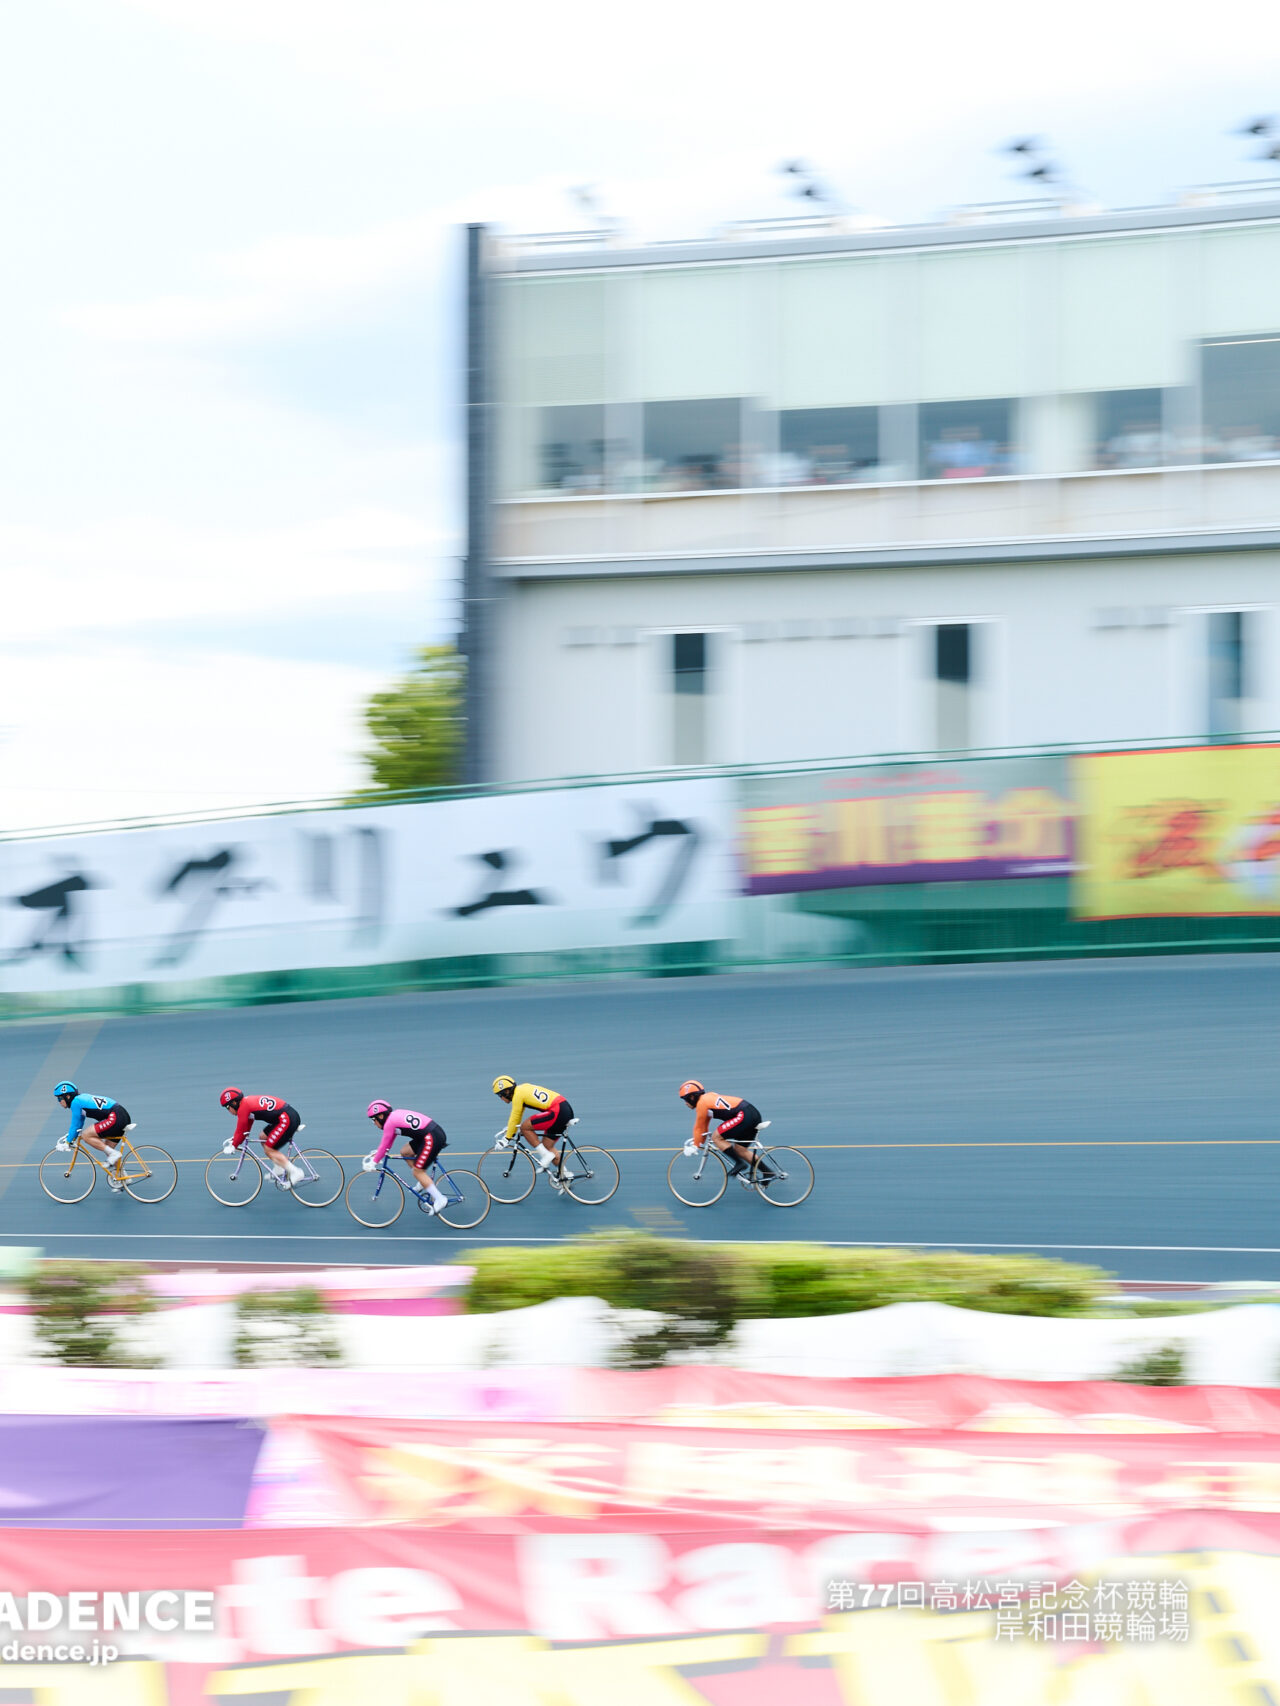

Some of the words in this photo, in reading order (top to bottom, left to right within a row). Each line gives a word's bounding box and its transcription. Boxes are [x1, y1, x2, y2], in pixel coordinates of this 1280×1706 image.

[60, 1085, 67, 1093] 4
[533, 1088, 549, 1103] 5
[92, 1096, 108, 1110] 4
[224, 1092, 231, 1101] 3
[259, 1095, 276, 1111] 3
[715, 1097, 730, 1110] 7
[405, 1114, 421, 1130] 8
